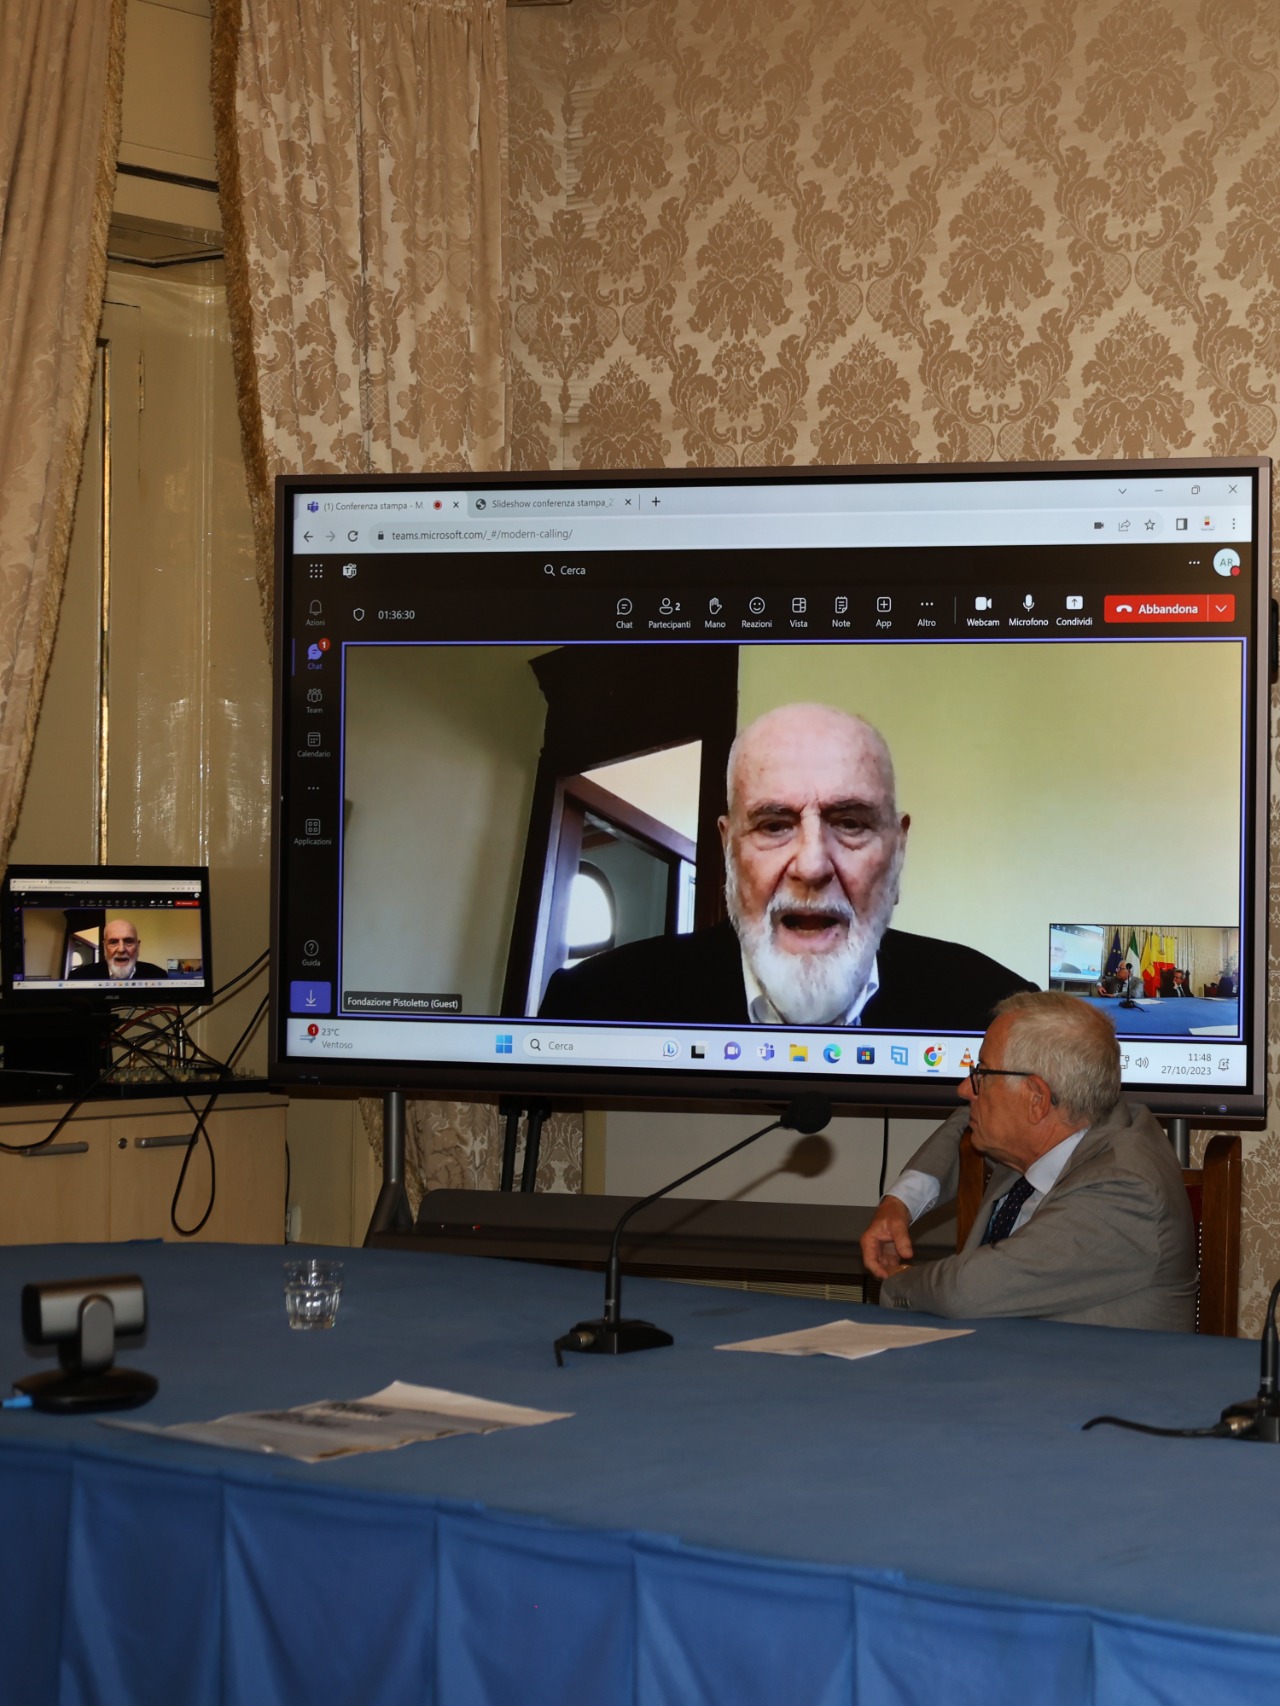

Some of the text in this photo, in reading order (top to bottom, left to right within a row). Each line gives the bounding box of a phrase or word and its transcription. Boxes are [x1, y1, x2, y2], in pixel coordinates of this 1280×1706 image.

[323, 501, 334, 512] (1)
[335, 500, 378, 511] Conferenza
[379, 501, 407, 512] stampa
[492, 498, 531, 509] Slideshow
[532, 497, 574, 508] conferenza
[391, 528, 573, 542] teams.microsoft.com/_#/modern-calling/
[1219, 557, 1234, 567] AR
[559, 564, 586, 576] Cerca
[675, 602, 681, 611] 2
[1138, 604, 1198, 615] Abbandona
[378, 609, 416, 620] 01:36:30
[305, 618, 326, 627] Azioni
[615, 620, 633, 629] Chat
[648, 620, 691, 630] Partecipanti
[704, 620, 726, 629] Mano
[741, 619, 773, 628] Reazioni
[789, 619, 808, 628] Vista
[831, 619, 851, 628] Note
[875, 619, 892, 629] App
[917, 618, 936, 627] Altro
[966, 618, 1000, 627] Webcam
[1008, 617, 1049, 626] Microfono
[1056, 617, 1093, 626] Condividi
[307, 662, 323, 670] Chat
[306, 706, 323, 714] Team
[297, 750, 331, 758] Calendario
[293, 837, 332, 846] Applicazioni
[301, 959, 321, 967] Guida
[347, 996, 459, 1010] Fondazione Pistoletto (Guest)
[321, 1028, 340, 1037] 23°C
[321, 1040, 353, 1050] Ventoso
[548, 1041, 574, 1051] Cerca
[1188, 1053, 1212, 1062] 11:48
[1161, 1066, 1212, 1075] 27/10/2023
